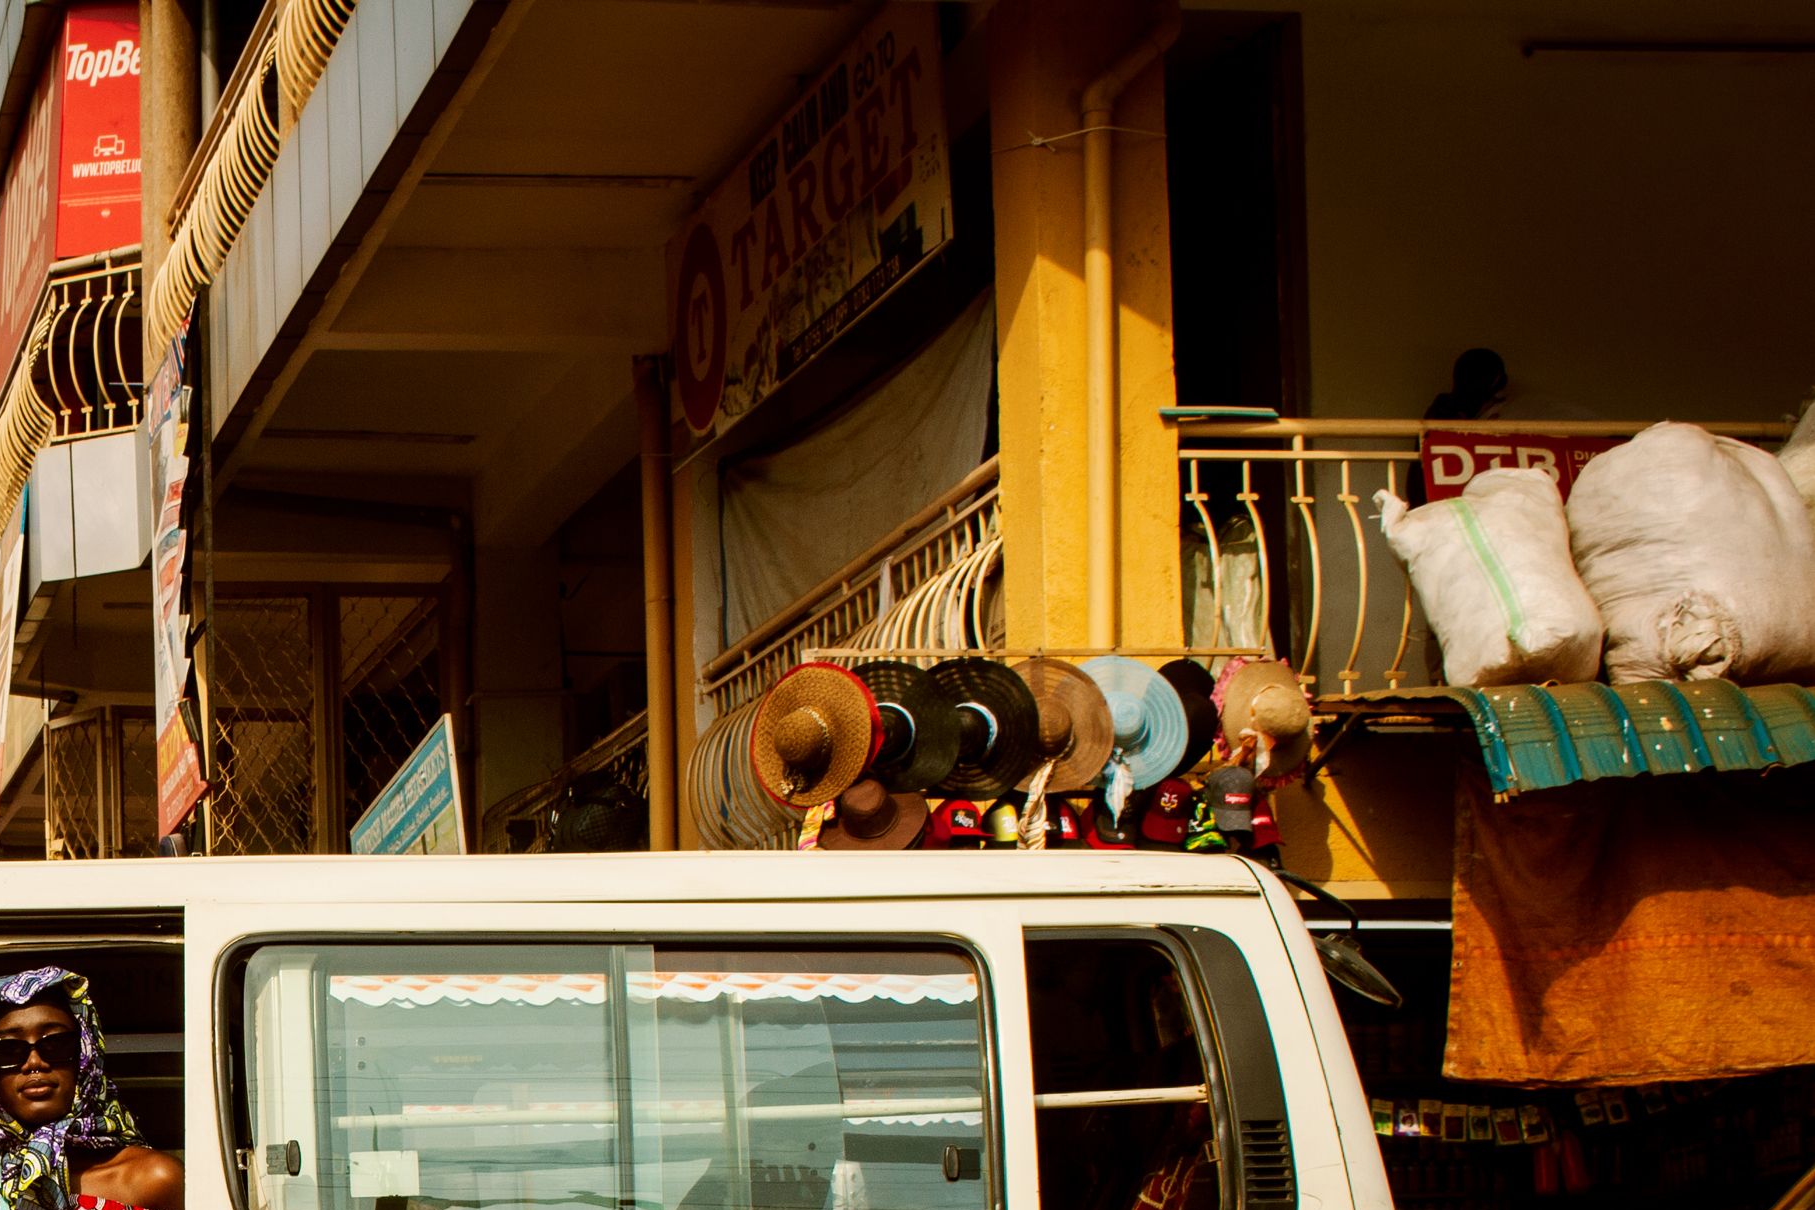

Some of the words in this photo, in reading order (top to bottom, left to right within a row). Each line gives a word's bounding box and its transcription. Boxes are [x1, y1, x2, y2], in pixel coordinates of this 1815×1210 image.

[66, 40, 141, 87] TopBe
[731, 46, 922, 313] TARGET
[690, 291, 709, 363] T
[1429, 444, 1561, 486] DTB
